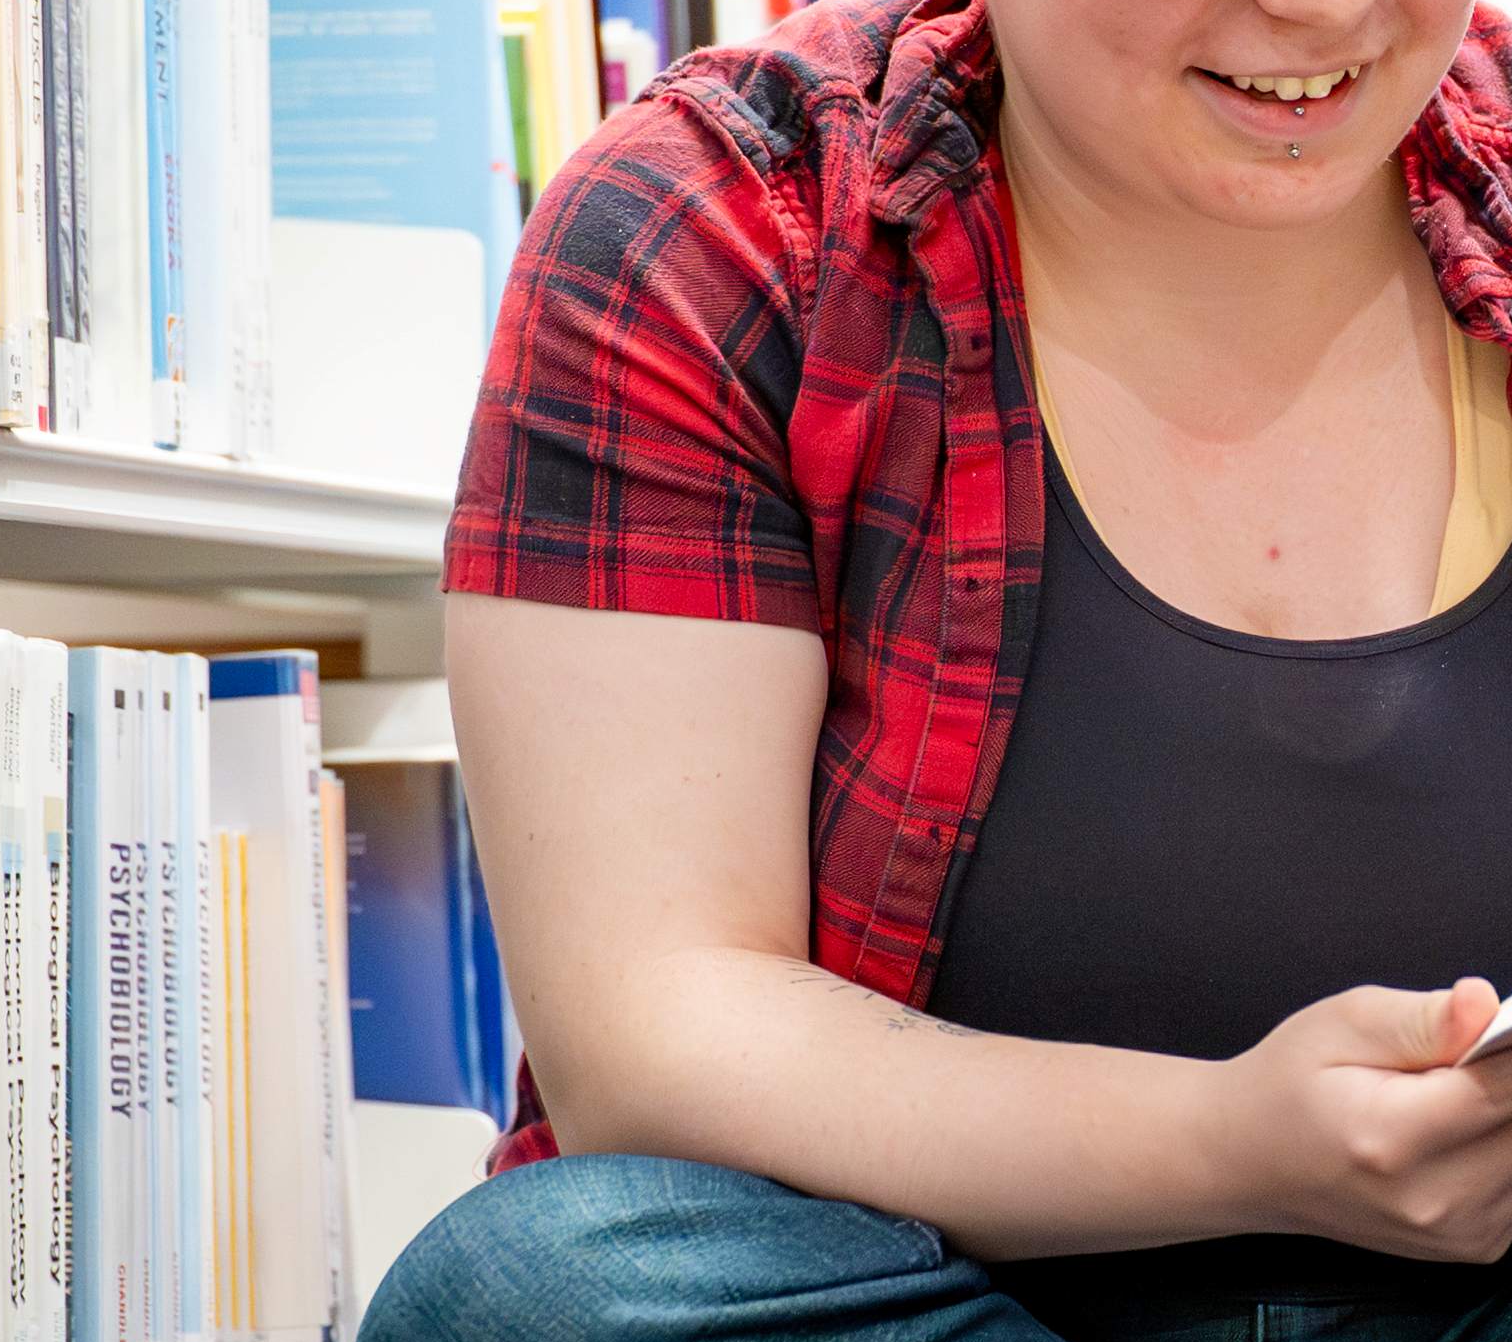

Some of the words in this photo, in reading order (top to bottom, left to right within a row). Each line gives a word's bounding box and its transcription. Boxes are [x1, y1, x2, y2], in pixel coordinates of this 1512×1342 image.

[3, 872, 14, 1066] Biological
[46, 861, 61, 1049] Biological
[109, 842, 133, 1122] PSYCHOBIOLOGY
[135, 841, 149, 1113] PSYCHOBIOLOGY
[161, 840, 179, 1108] PSYCHOBIOLOGY
[197, 839, 212, 1106] PSYCHOBIOLOGY
[48, 1063, 64, 1287] Psychology
